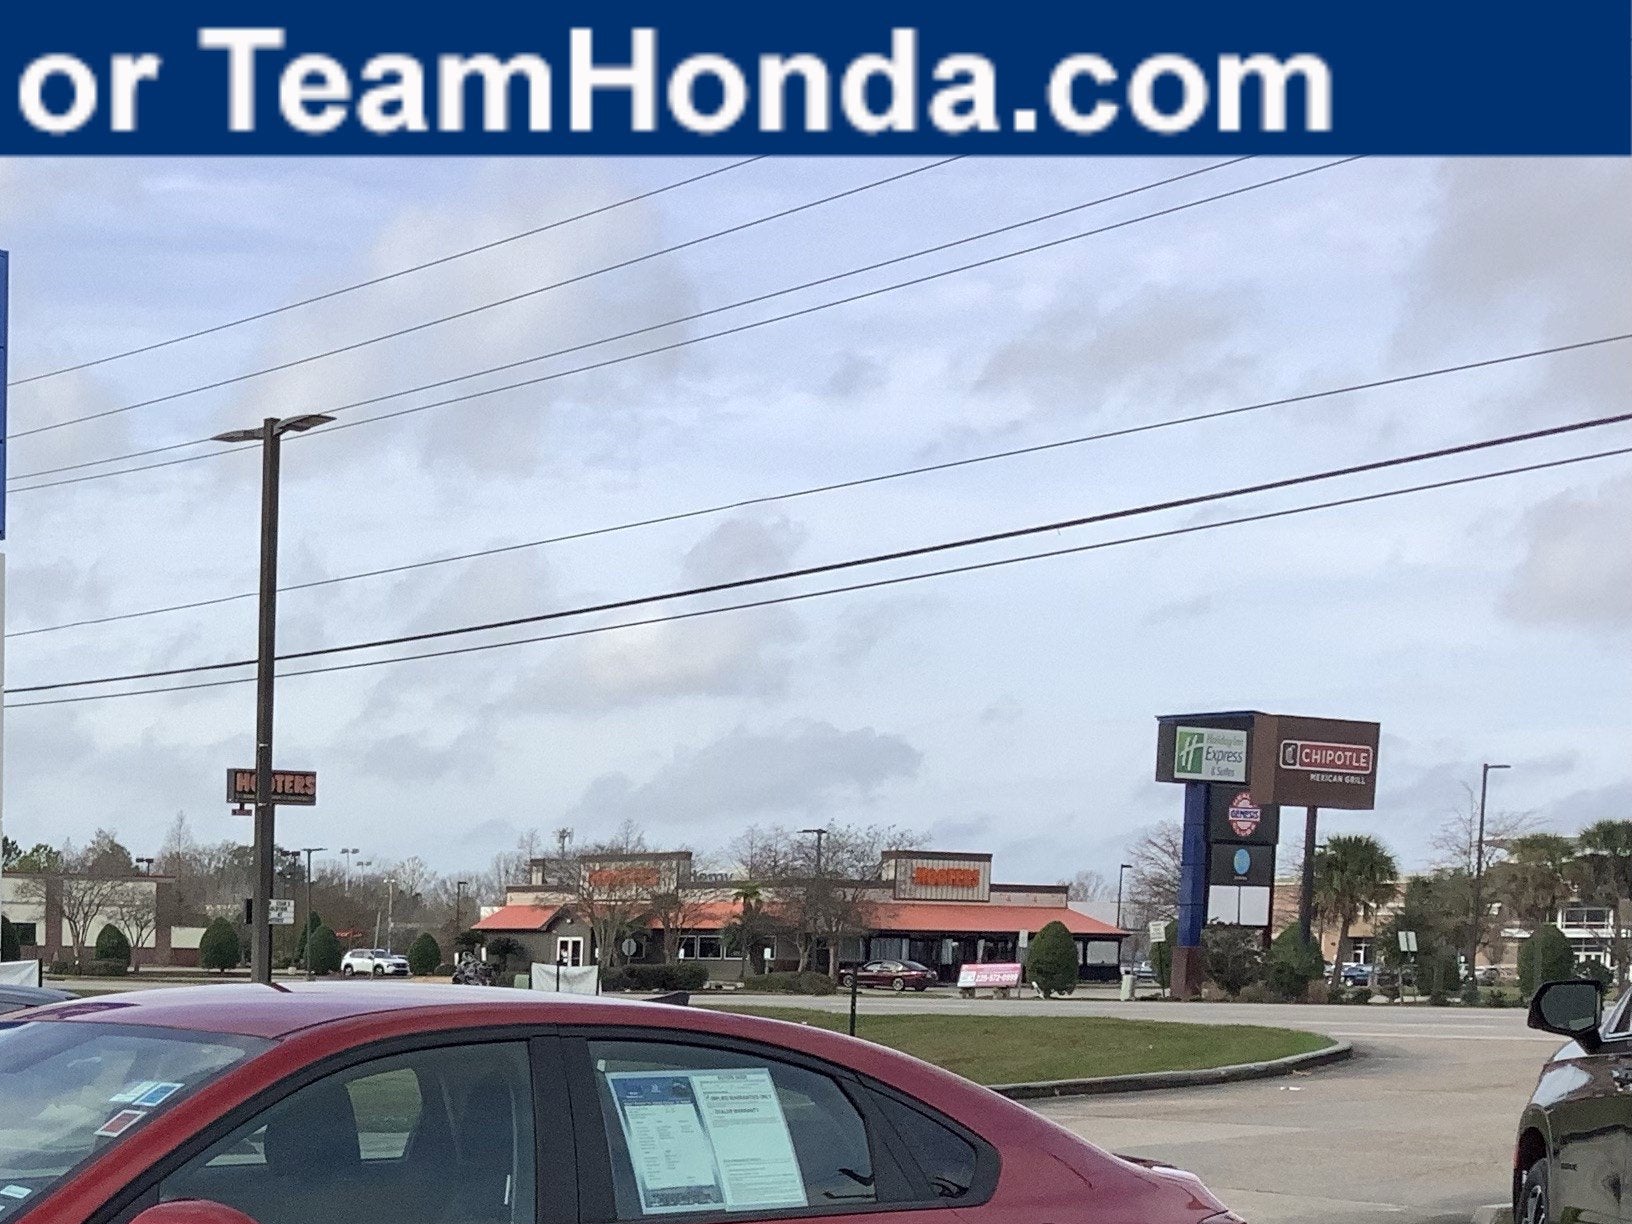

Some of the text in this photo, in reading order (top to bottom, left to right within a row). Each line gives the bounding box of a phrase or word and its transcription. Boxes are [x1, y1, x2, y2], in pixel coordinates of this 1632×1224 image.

[1205, 746, 1243, 764] Express
[1302, 748, 1369, 768] CHIPOTLE
[1217, 767, 1235, 777] Suites
[1310, 773, 1366, 785] MEXICAN GRILL
